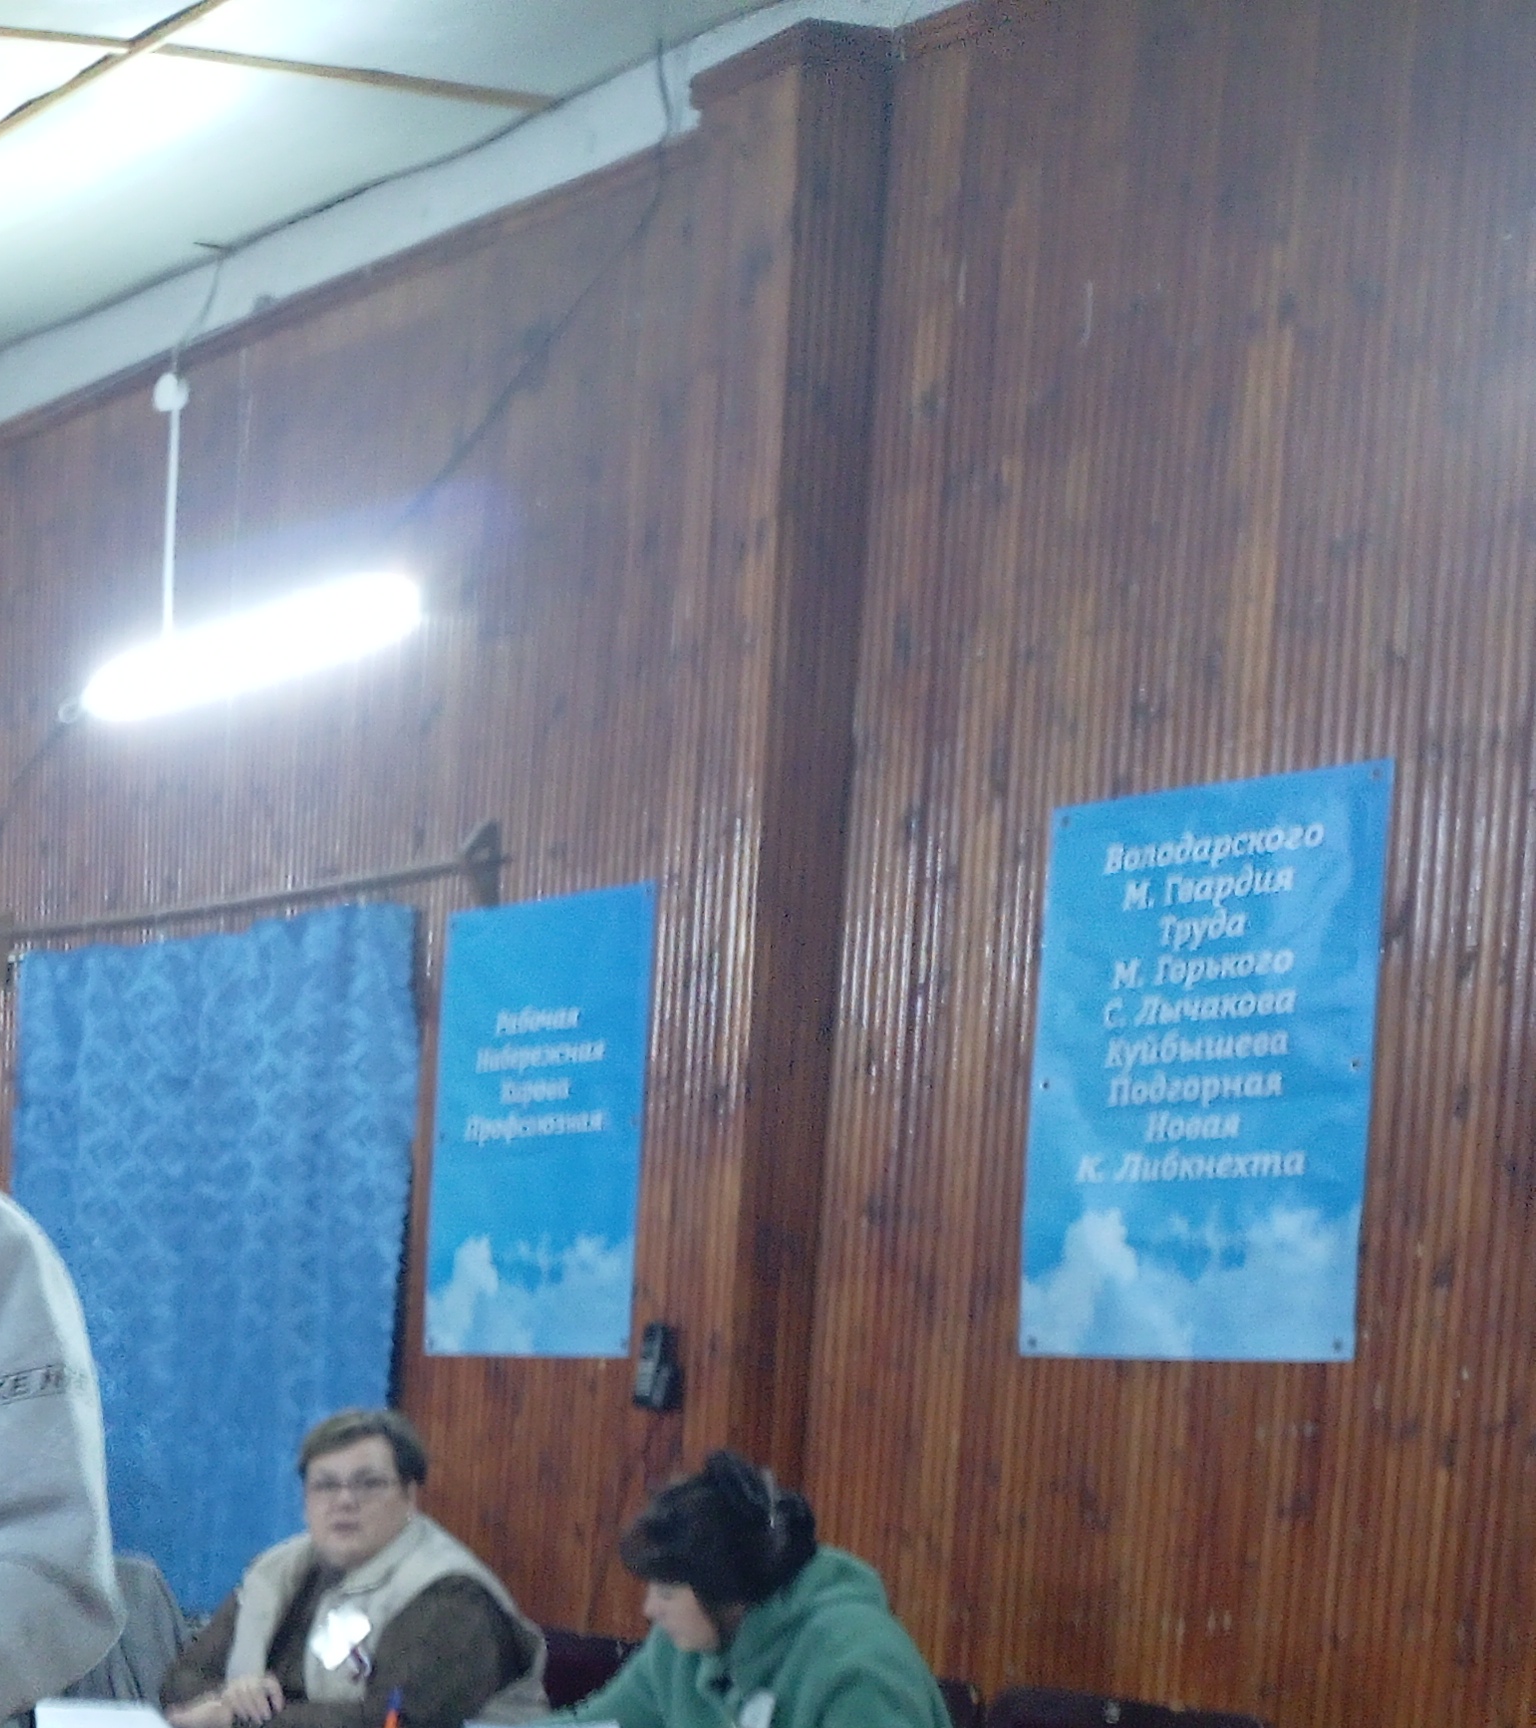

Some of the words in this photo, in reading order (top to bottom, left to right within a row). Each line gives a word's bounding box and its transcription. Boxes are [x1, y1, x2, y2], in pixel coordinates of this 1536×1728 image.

[1105, 825, 1324, 874] Володарского
[1123, 878, 1155, 911] М.
[1165, 865, 1294, 907] Гвардия
[1160, 910, 1247, 950] Труда
[1112, 956, 1144, 990] М.
[1155, 951, 1293, 989] Горького
[1106, 1031, 1288, 1071] Куйбышева
[1108, 1070, 1283, 1108] Подгорная
[1145, 1111, 1242, 1143] Новая
[1114, 1149, 1307, 1182] Либкнехта
